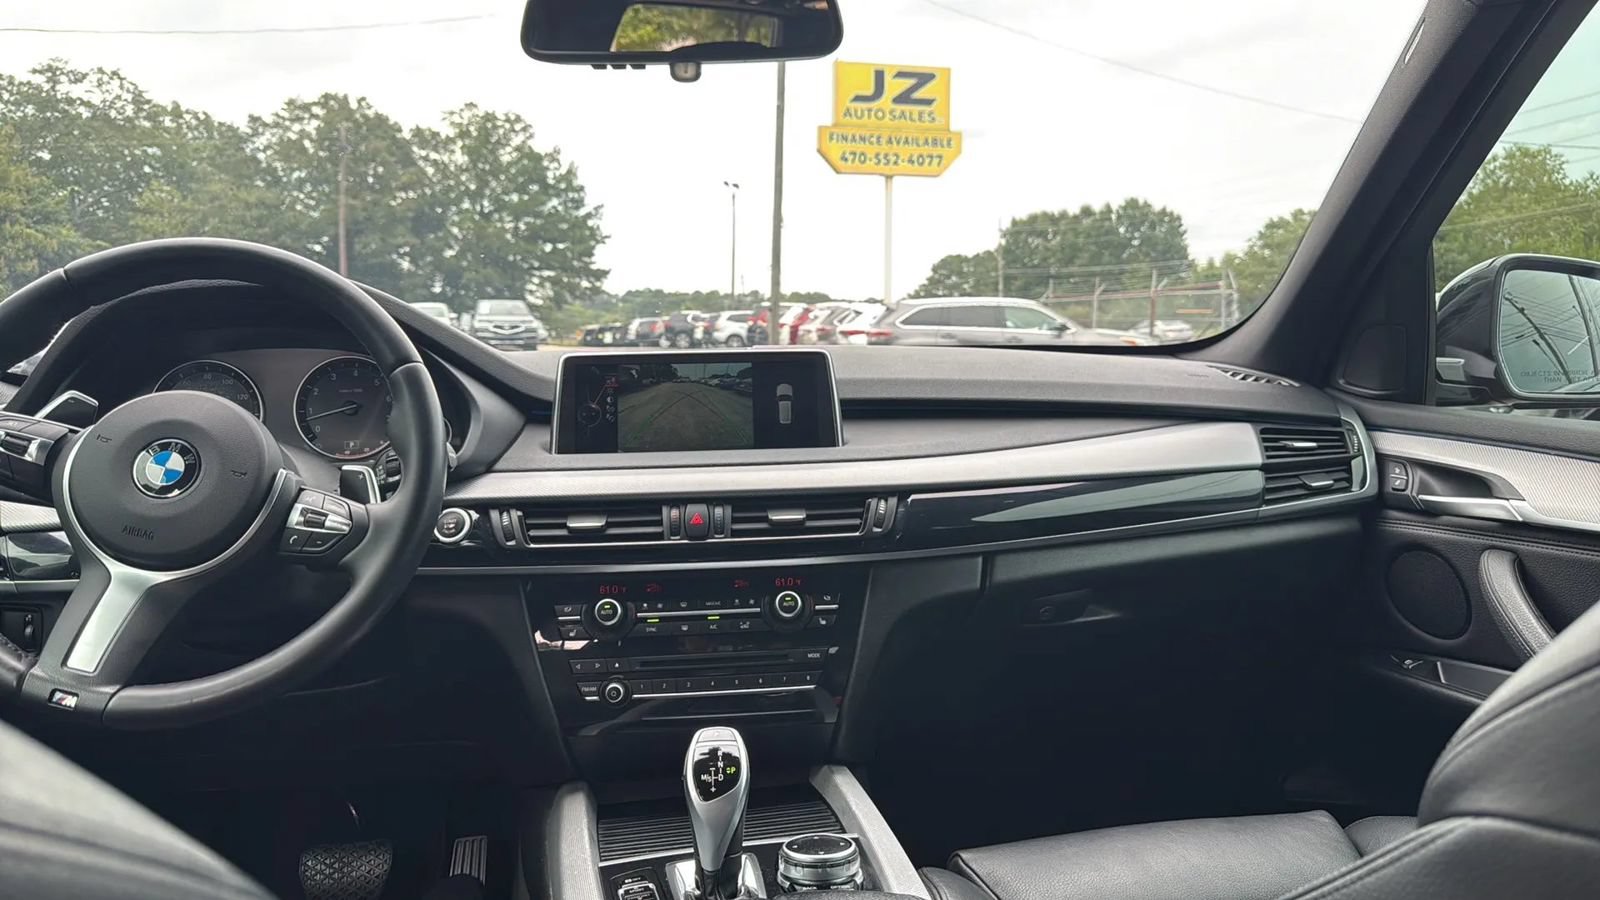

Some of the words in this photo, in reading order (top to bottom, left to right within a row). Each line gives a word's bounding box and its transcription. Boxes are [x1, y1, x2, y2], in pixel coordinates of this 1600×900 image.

[849, 69, 937, 106] JZ
[843, 107, 886, 121] AUTO
[888, 108, 936, 123] SALES
[828, 131, 883, 146] FINANCE
[886, 135, 953, 149] AVAILABLE
[313, 387, 320, 396] 2
[148, 441, 196, 465] BMW
[121, 525, 155, 541] AIRBAG
